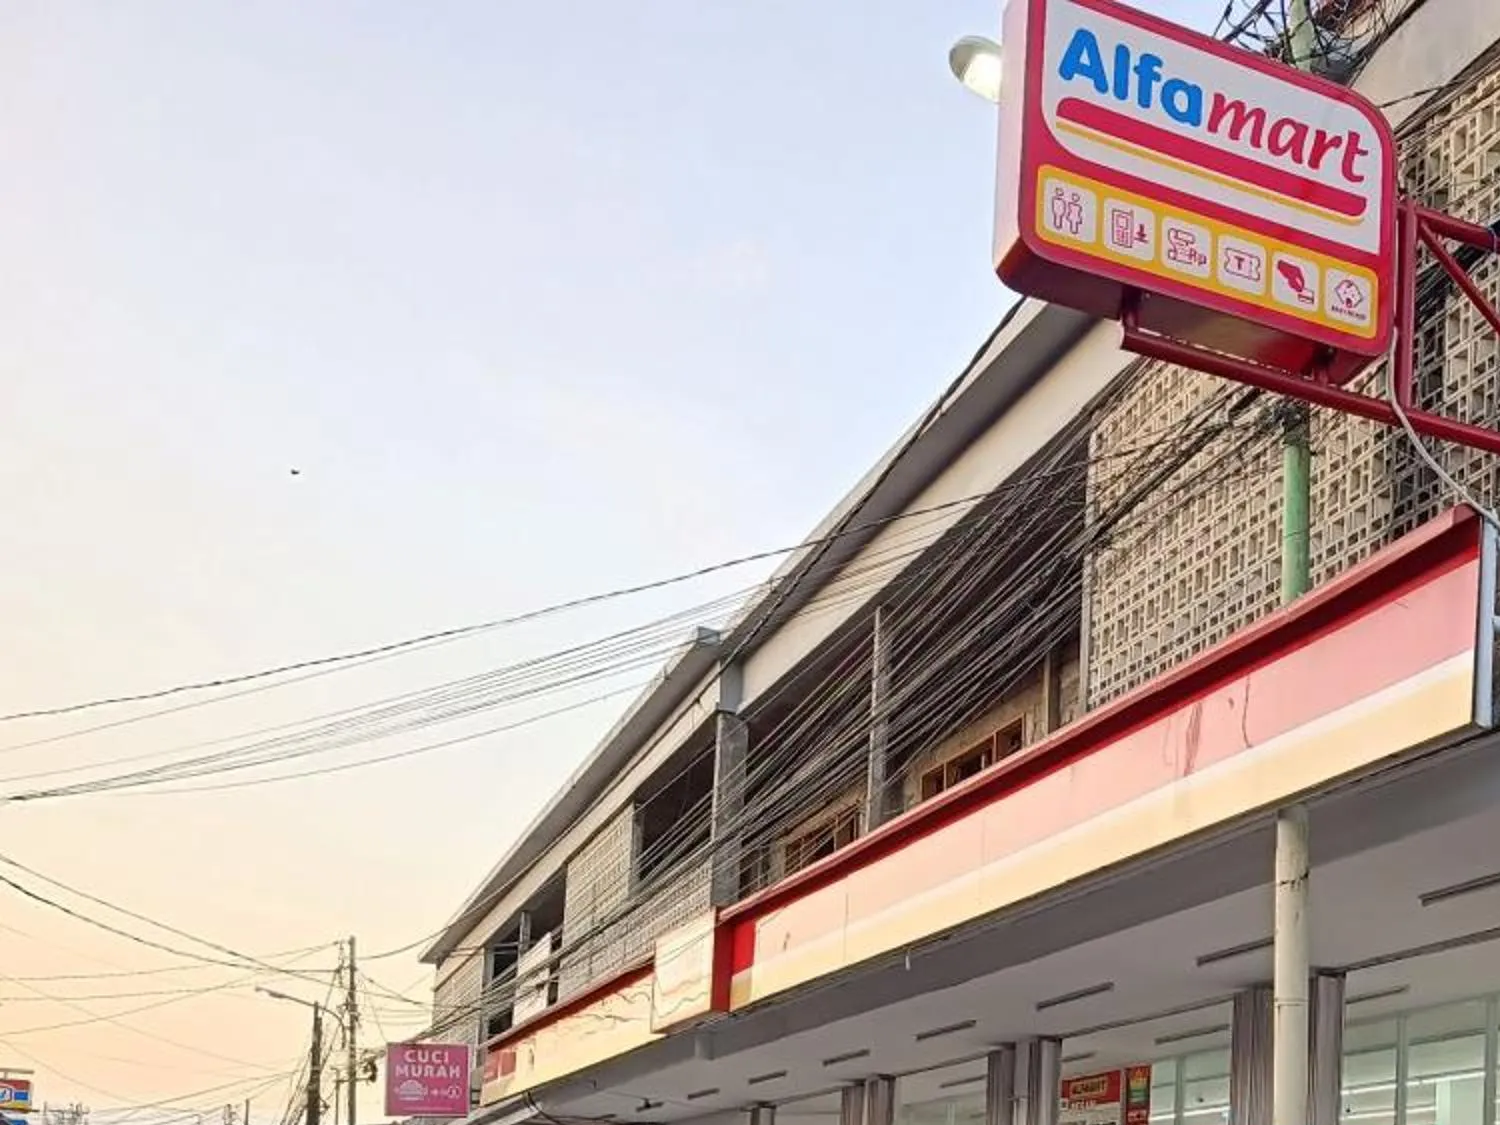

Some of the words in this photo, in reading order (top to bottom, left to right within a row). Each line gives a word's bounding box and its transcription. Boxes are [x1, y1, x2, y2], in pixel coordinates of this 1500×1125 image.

[1058, 27, 1370, 184] Alfamart
[404, 1049, 449, 1064] CUCI
[395, 1064, 461, 1079] MURAH
